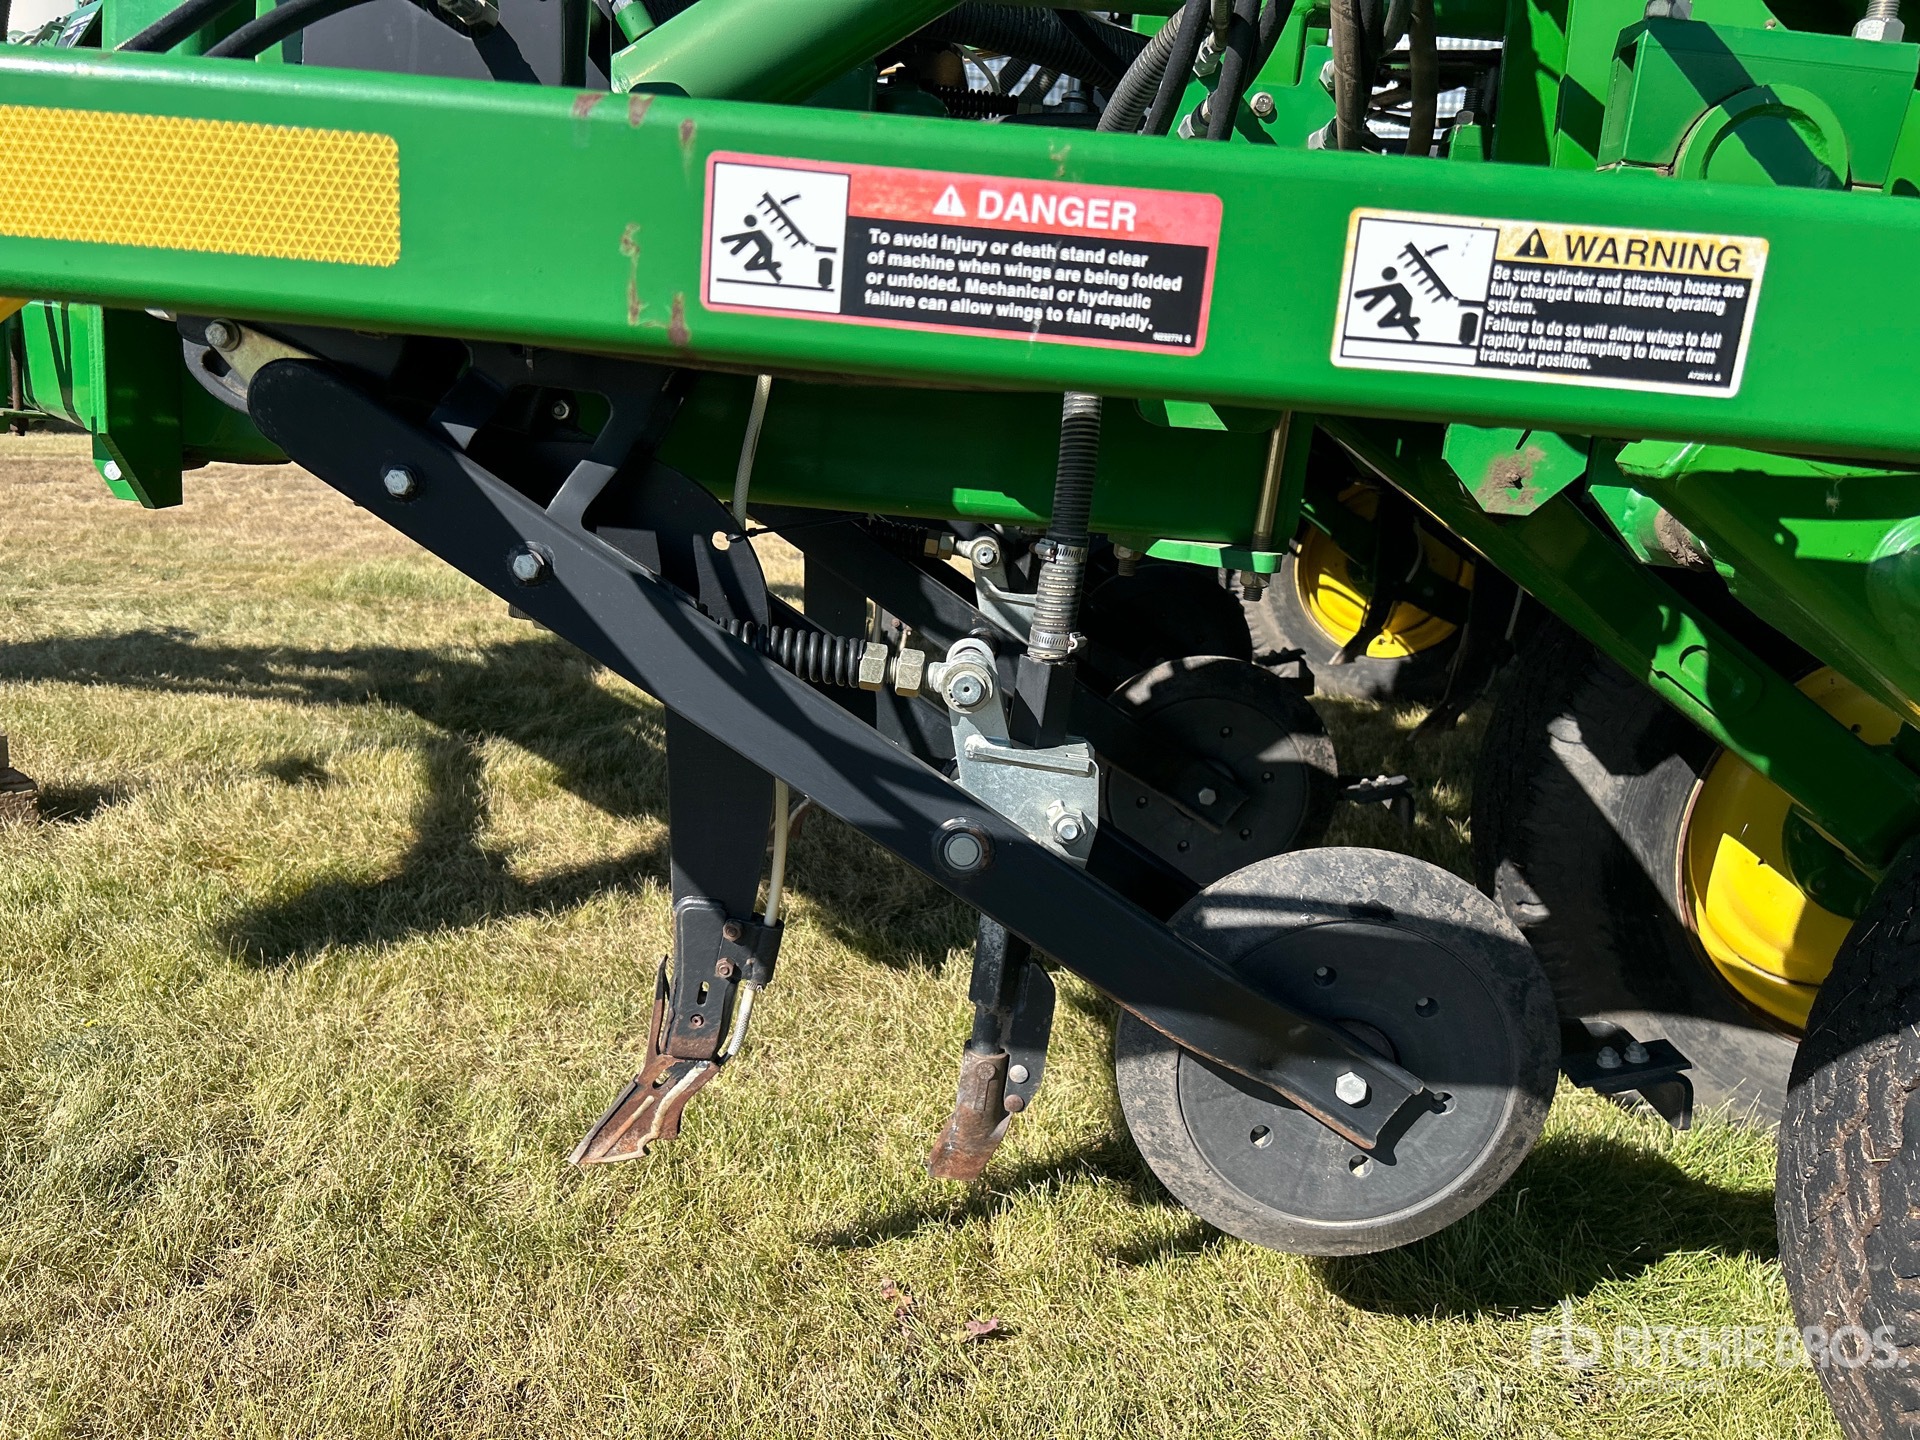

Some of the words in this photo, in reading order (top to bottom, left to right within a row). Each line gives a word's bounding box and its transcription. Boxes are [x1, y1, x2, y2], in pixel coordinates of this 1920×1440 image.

[977, 189, 1138, 232] DANGER
[868, 227, 891, 246] To
[892, 232, 939, 250] avoid
[940, 234, 988, 257] injury
[989, 241, 1010, 256] or
[1010, 241, 1057, 261] death
[1059, 246, 1106, 264] stand
[1107, 249, 1149, 268] clear
[1565, 234, 1742, 273] WARNING
[867, 249, 886, 266] of
[887, 253, 956, 272] machine
[957, 257, 1002, 276] when
[1003, 261, 1052, 283] wings
[1053, 267, 1082, 283] are
[1083, 267, 1130, 290] being
[1131, 271, 1183, 292] folded
[1492, 264, 1512, 280] Be
[1512, 268, 1542, 283] sure
[1543, 269, 1595, 288] cylinder
[1596, 272, 1623, 289] and
[1624, 274, 1683, 295] attaching
[1683, 277, 1723, 296] hoses
[1722, 283, 1746, 299] are
[865, 271, 885, 286] or
[886, 272, 962, 293] unfolded.
[964, 277, 1055, 299] Mechanical
[1056, 288, 1076, 303] or
[1077, 287, 1152, 310] hydraulic
[1486, 298, 1537, 315] system.
[1490, 281, 1519, 300] fully
[1520, 283, 1573, 303] charged
[1573, 287, 1603, 304] with
[1603, 290, 1621, 305] oil
[1622, 290, 1665, 309] before
[1665, 294, 1727, 316] operating
[864, 288, 916, 309] failure
[917, 296, 948, 312] can
[949, 297, 994, 316] allow
[995, 301, 1044, 323] wings
[1045, 306, 1064, 322] to
[1065, 307, 1092, 325] fall
[1093, 311, 1154, 332] rapidly.
[1480, 333, 1527, 352] rapidly
[1527, 335, 1563, 351] when
[1564, 338, 1633, 360] attempting
[1633, 343, 1648, 359] to
[1648, 344, 1686, 362] lower
[1685, 347, 1717, 365] from
[1484, 315, 1530, 334] Failure
[1531, 319, 1545, 334] to
[1546, 320, 1564, 337] do
[1564, 324, 1582, 338] so
[1583, 324, 1609, 340] will
[1608, 325, 1645, 341] allow
[1646, 328, 1685, 346] wings
[1684, 330, 1700, 347] to
[1699, 331, 1723, 349] fall
[1479, 347, 1537, 367] transport
[1537, 353, 1592, 370] position.
